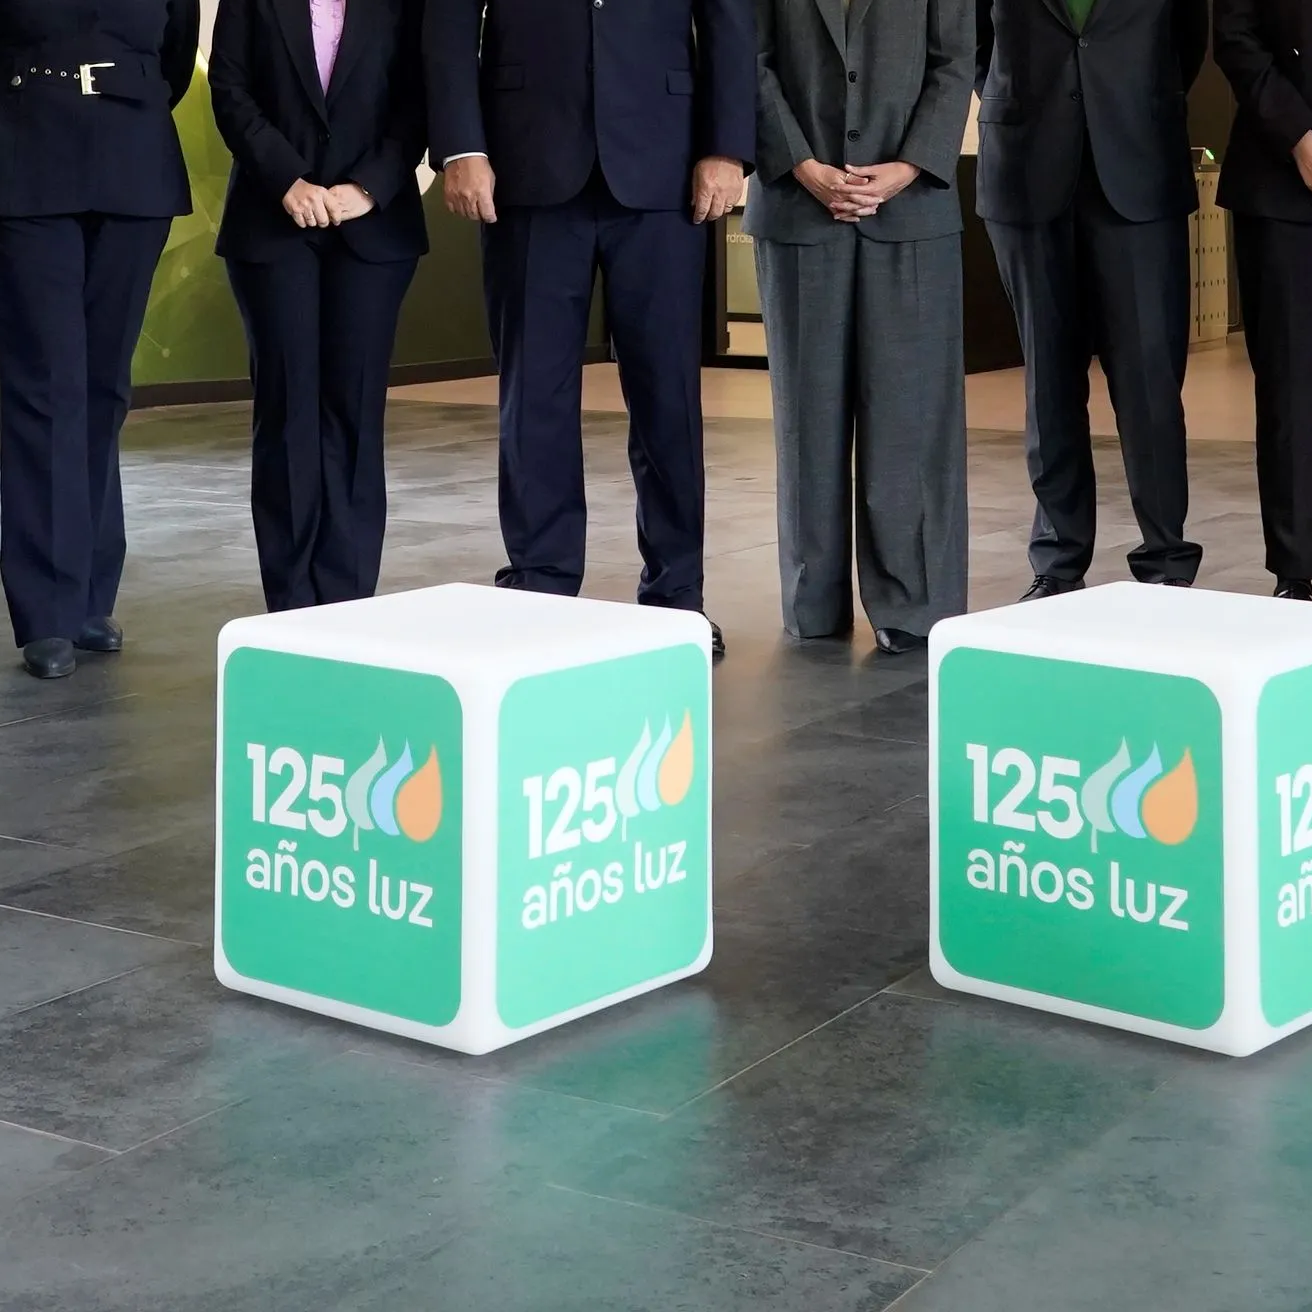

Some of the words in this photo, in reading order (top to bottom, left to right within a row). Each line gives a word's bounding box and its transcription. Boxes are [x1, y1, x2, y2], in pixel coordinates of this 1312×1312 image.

[246, 742, 348, 839] 125
[521, 757, 616, 861] 125
[966, 743, 1083, 841] 125
[246, 839, 356, 910] años
[368, 856, 435, 930] luz
[521, 854, 626, 932] años
[633, 839, 687, 895] luz
[966, 840, 1096, 911] años
[1109, 856, 1190, 932] luz
